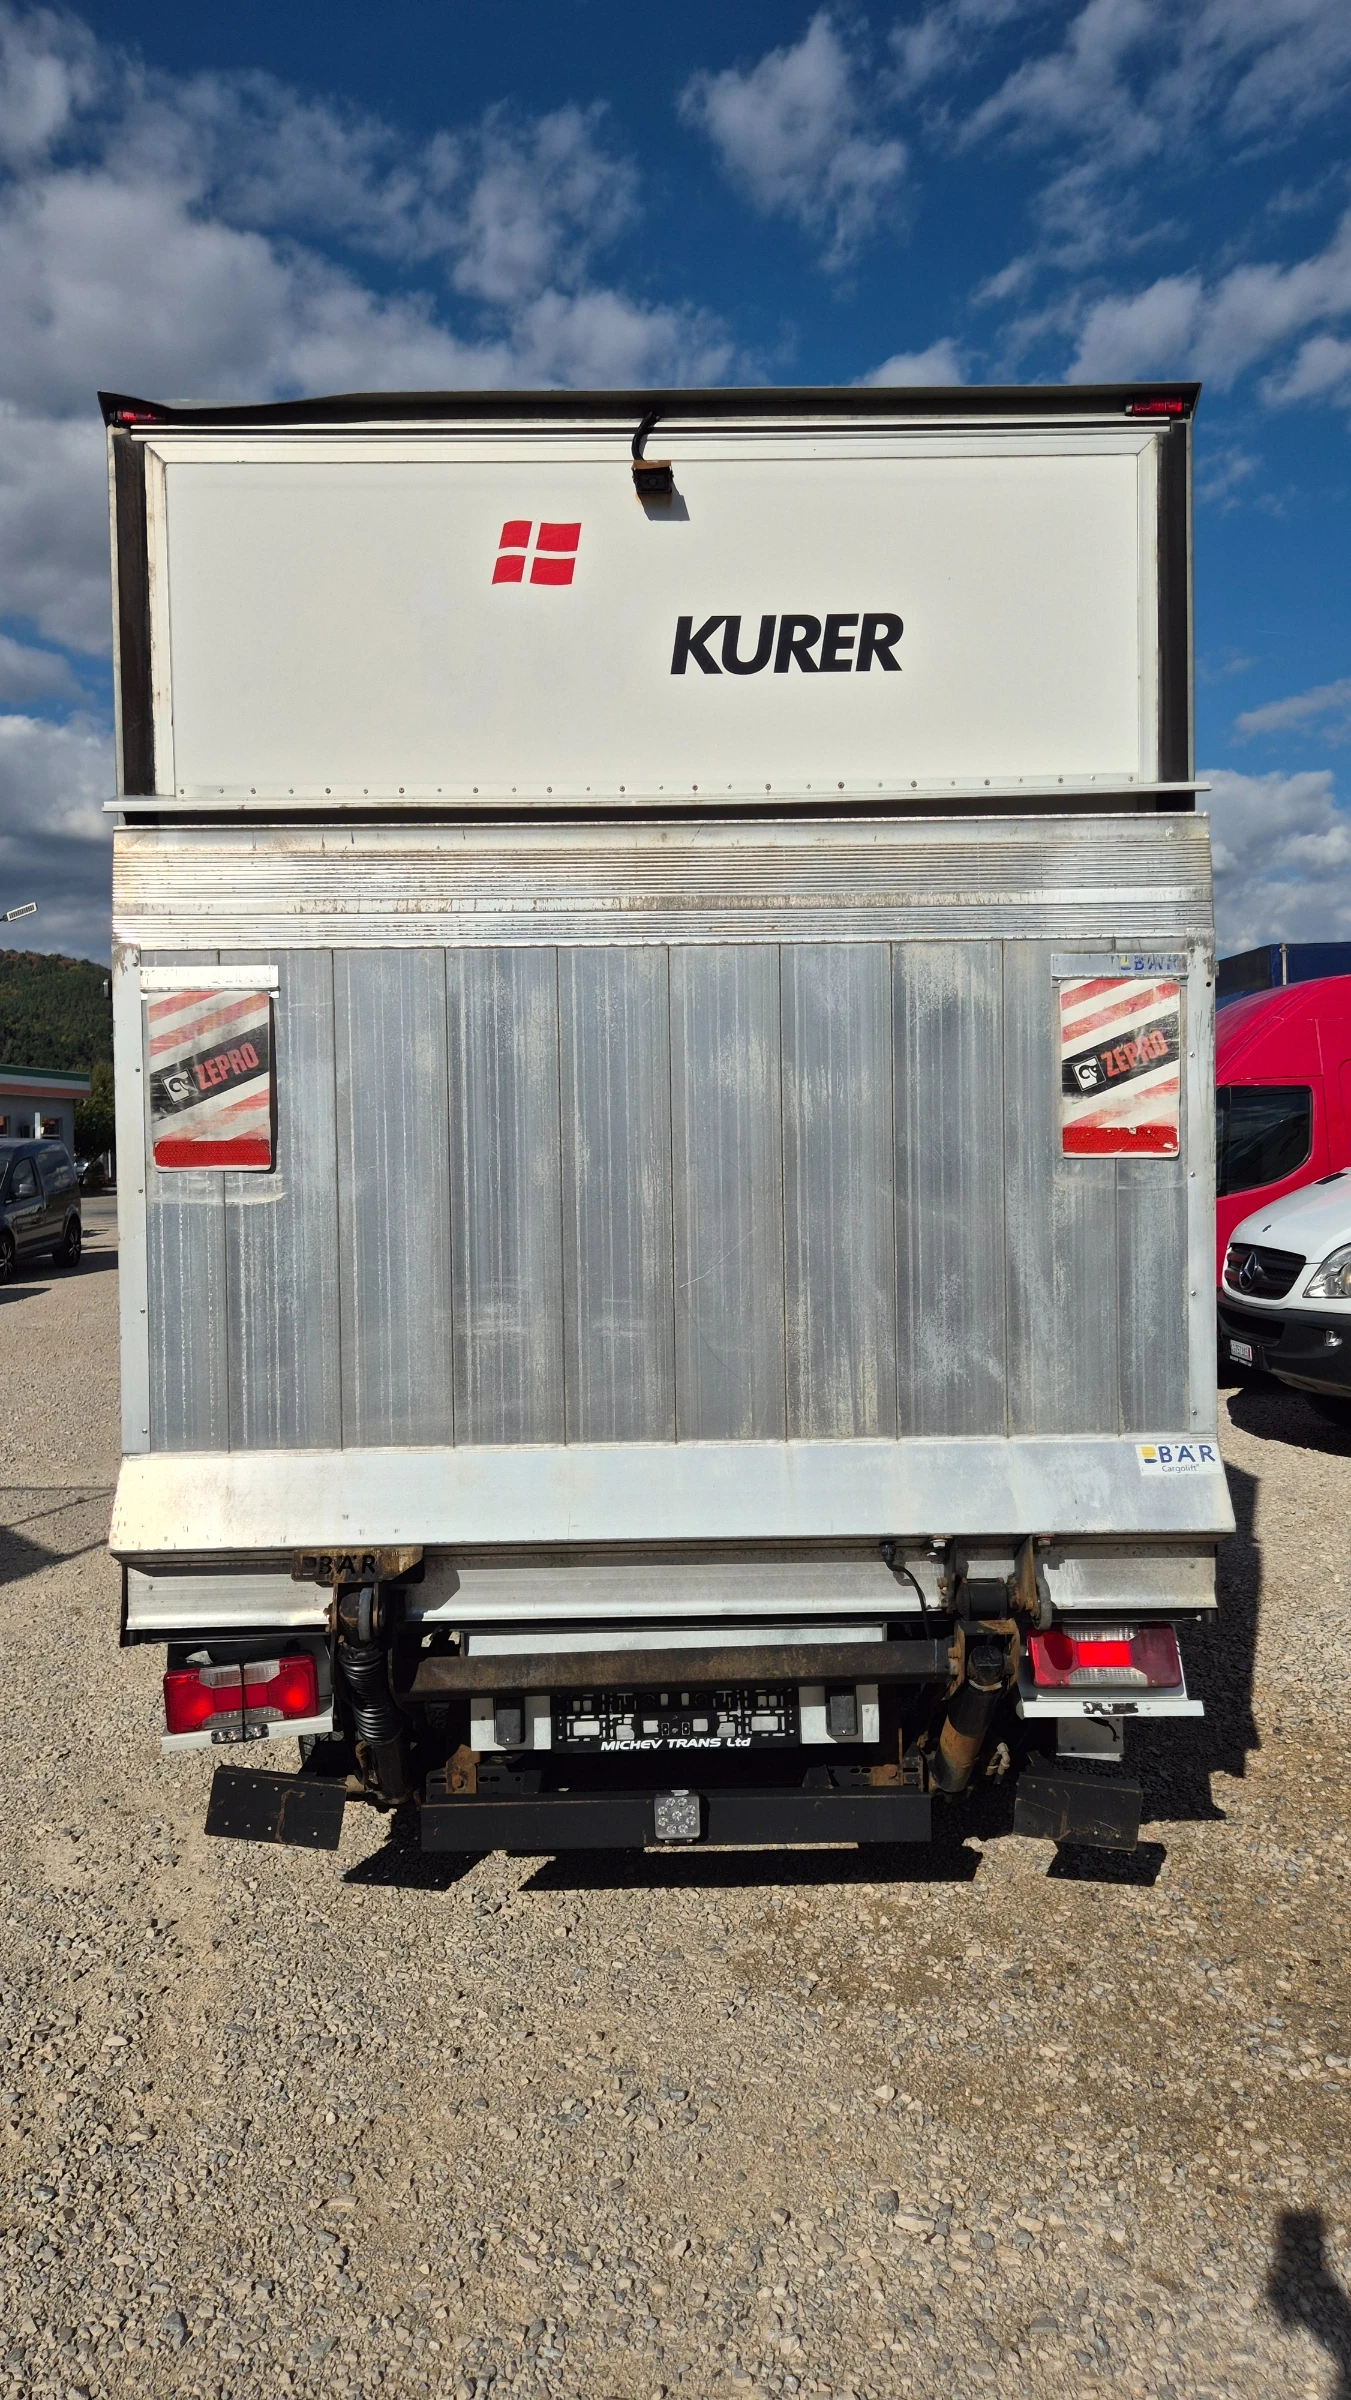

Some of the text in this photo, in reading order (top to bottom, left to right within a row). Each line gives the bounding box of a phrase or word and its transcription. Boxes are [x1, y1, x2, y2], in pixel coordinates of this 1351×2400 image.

[670, 613, 904, 675] KURER
[192, 1042, 259, 1090] ZEPRO
[1100, 1030, 1168, 1077] ZEPRO
[1158, 1444, 1216, 1463] BÄR
[319, 1554, 376, 1575] BÄR
[600, 1737, 751, 1751] MICHEV TRANS Ltd
